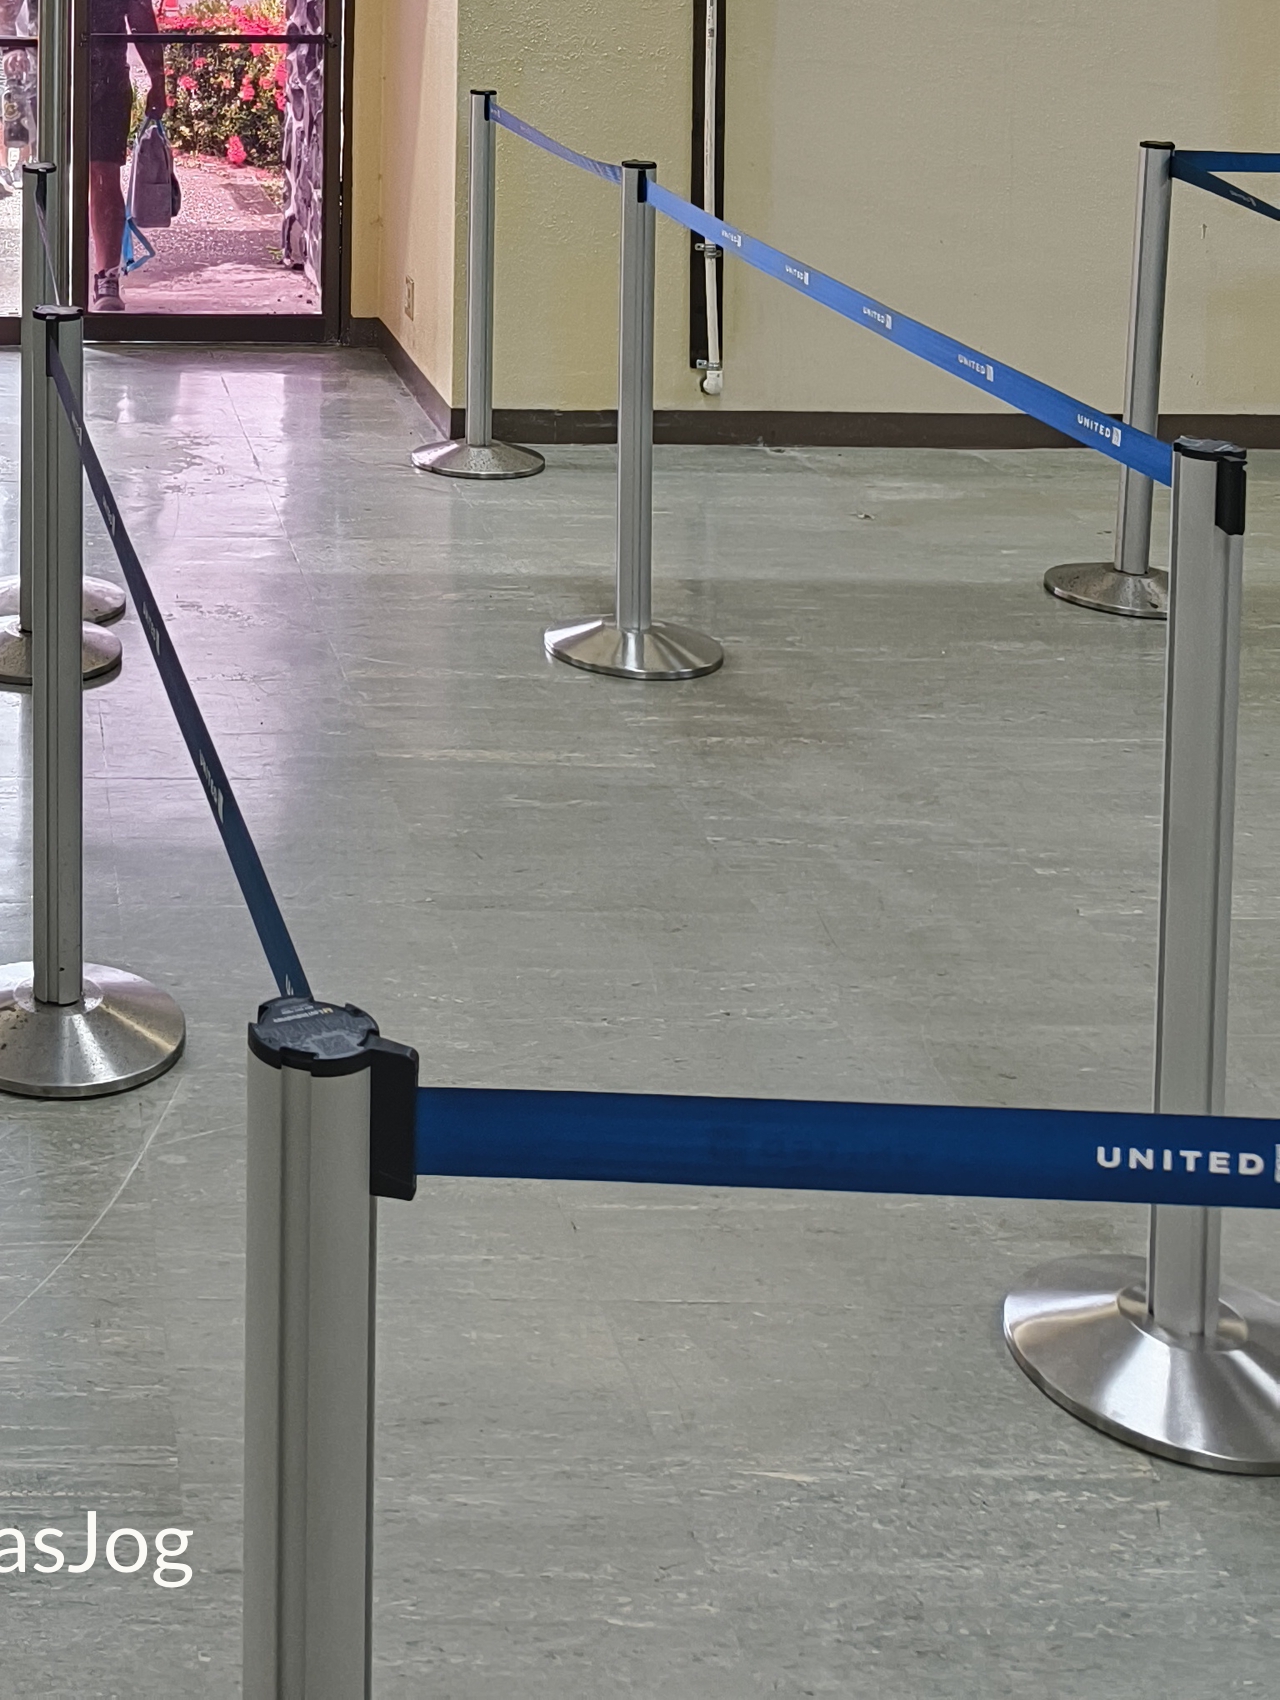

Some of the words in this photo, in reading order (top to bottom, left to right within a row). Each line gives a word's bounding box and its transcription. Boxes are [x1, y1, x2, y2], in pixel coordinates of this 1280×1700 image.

[957, 353, 986, 375] UNITED
[1077, 413, 1111, 438] UNITED
[1096, 1146, 1265, 1176] UNITED
